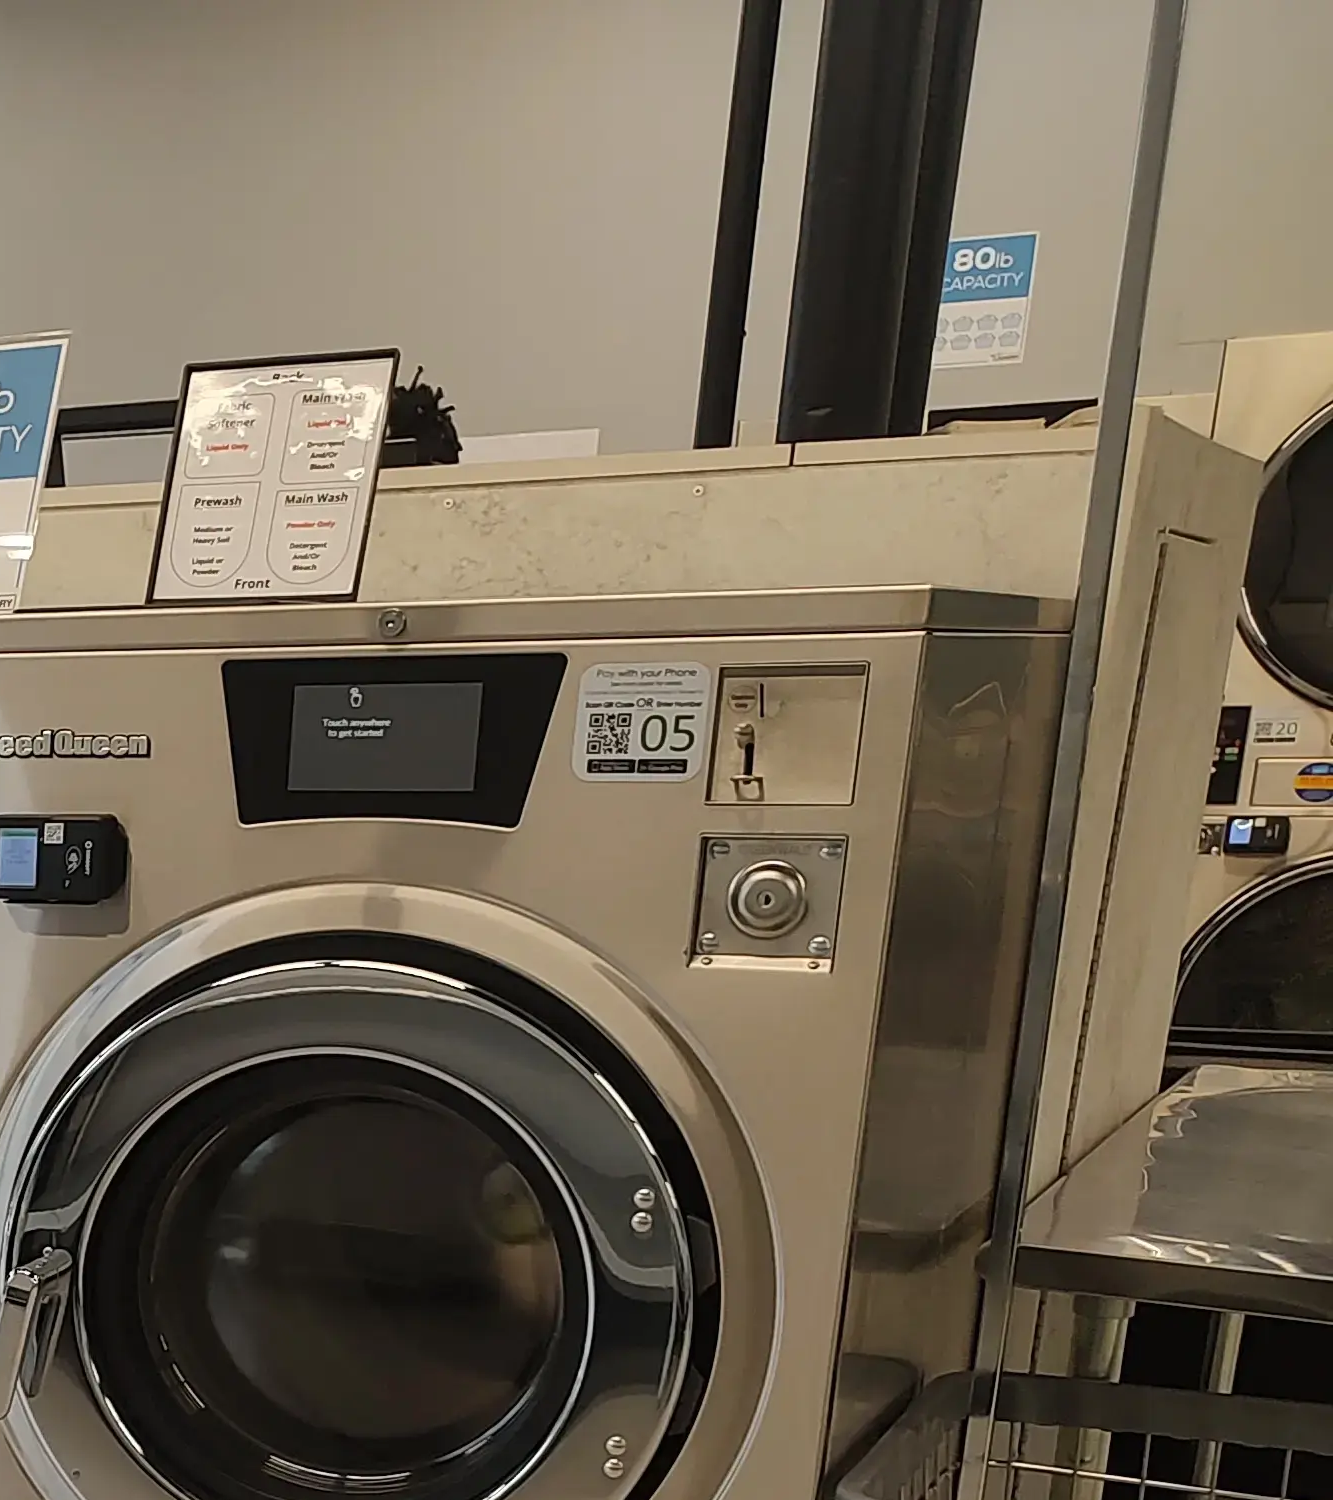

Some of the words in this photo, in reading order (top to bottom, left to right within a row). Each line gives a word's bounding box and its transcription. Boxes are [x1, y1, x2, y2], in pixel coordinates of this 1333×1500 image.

[943, 272, 1024, 291] CAPACITY
[302, 394, 330, 404] Main
[194, 497, 242, 507] Prewash
[285, 495, 313, 505] Main
[317, 492, 348, 503] Wash
[234, 578, 270, 589] Front
[641, 670, 662, 679] your
[664, 669, 697, 677] Phone
[636, 698, 653, 707] OR
[349, 719, 391, 727] anywhere
[640, 715, 695, 751] 05
[1276, 722, 1298, 735] 20
[338, 730, 352, 738] get
[54, 730, 150, 758] Queen
